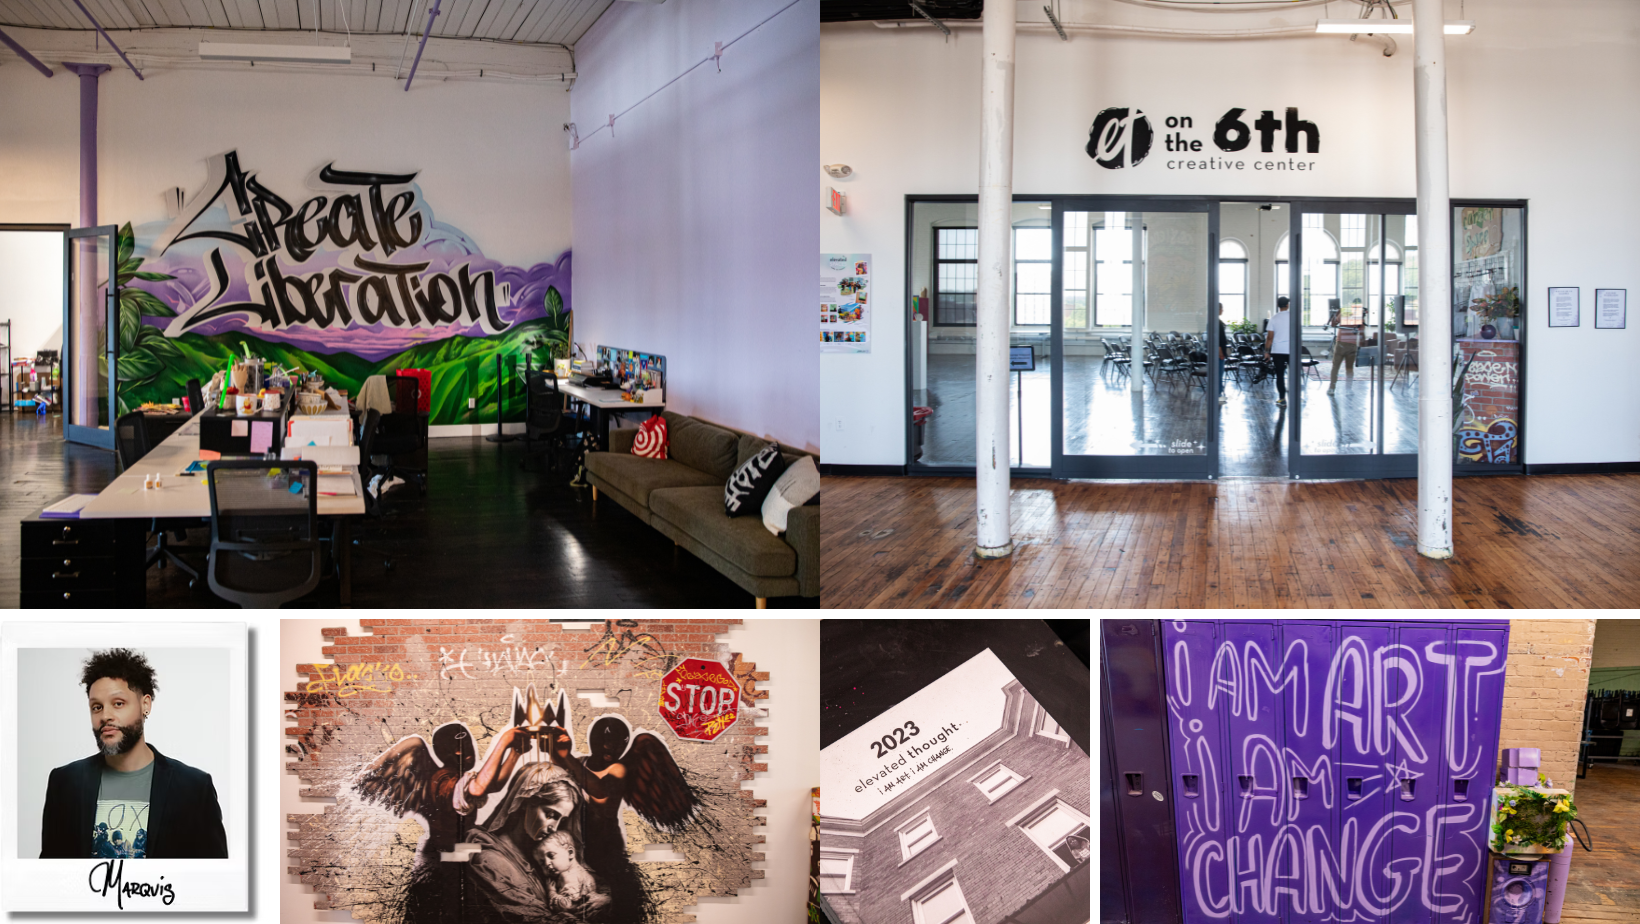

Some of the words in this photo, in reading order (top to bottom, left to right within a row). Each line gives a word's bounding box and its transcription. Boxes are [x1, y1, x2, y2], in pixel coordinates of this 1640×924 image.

[1165, 114, 1193, 129] on
[1165, 132, 1204, 153] the
[1213, 107, 1321, 154] 6th
[1167, 156, 1246, 171] creative
[1254, 157, 1316, 171] center
[1171, 438, 1192, 448] slide
[665, 682, 735, 715] STOP
[1207, 638, 1310, 737] AM
[1322, 635, 1500, 772] ART
[870, 720, 920, 759] 2023
[854, 753, 908, 793] elevated
[884, 781, 895, 792] AM
[916, 761, 928, 772] AM
[1238, 734, 1334, 832] AM
[1192, 803, 1478, 918] CHANGE
